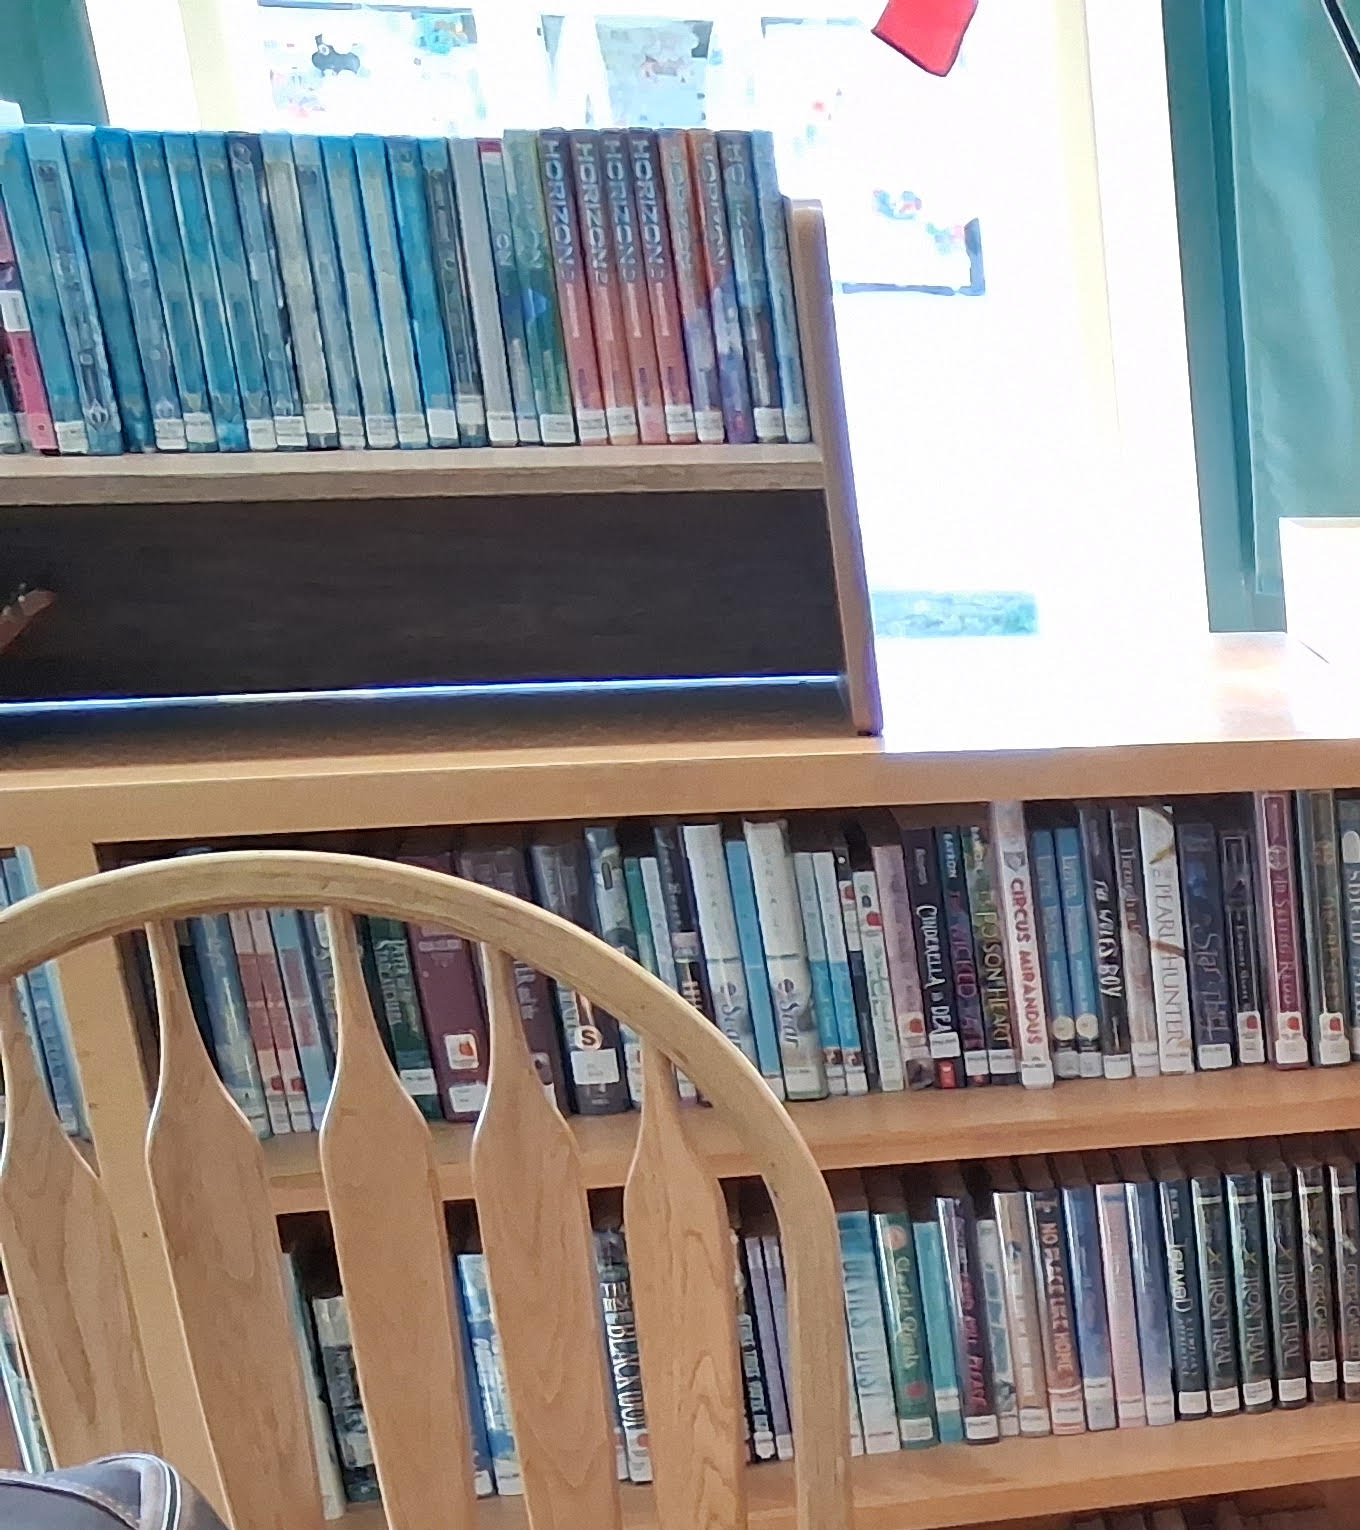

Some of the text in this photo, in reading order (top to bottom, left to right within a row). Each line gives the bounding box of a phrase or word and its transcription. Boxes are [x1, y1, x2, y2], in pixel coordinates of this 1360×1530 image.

[542, 140, 575, 272] HORIZON
[576, 142, 607, 269] HORIZON
[632, 139, 664, 265] HORIZON
[915, 905, 954, 1033] CINDERELLA DEA
[1009, 877, 1043, 1045] CIRCUS MIRANDUS
[1152, 879, 1190, 1046] PEARL HUNTER
[1041, 1223, 1059, 1246] NO
